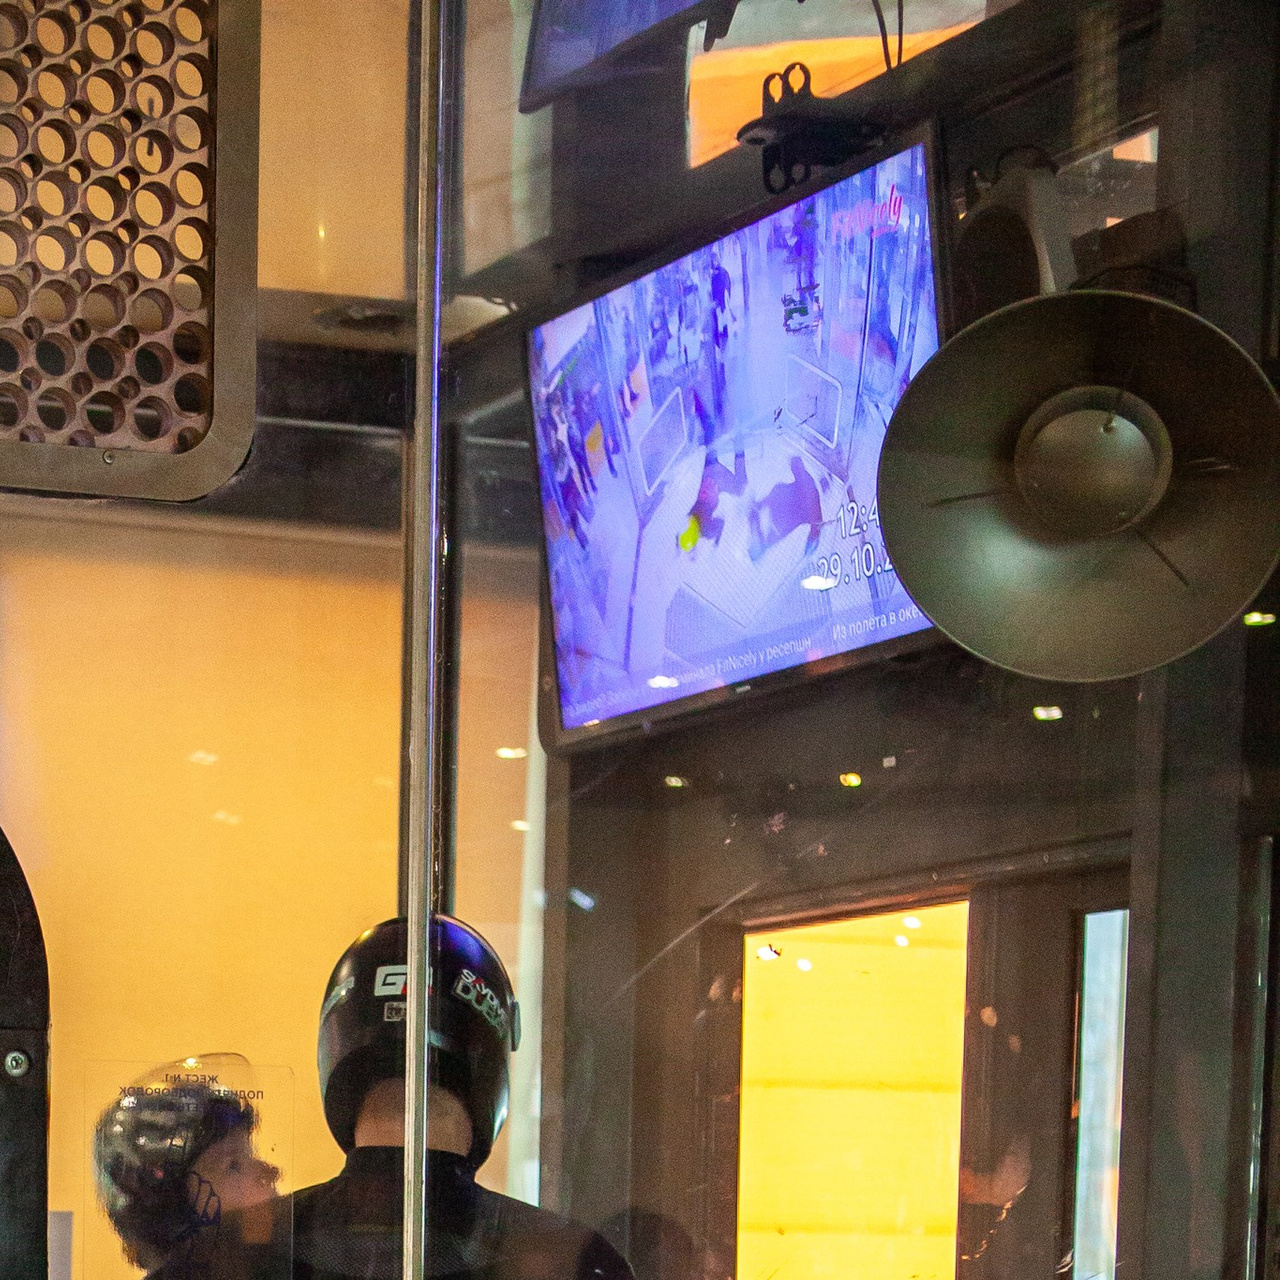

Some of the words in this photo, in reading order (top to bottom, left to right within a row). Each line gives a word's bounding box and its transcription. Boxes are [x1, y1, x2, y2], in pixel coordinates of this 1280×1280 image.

[835, 494, 880, 540] 12:4
[832, 624, 847, 640] Из
[889, 611, 897, 622] в
[898, 604, 923, 622] оке
